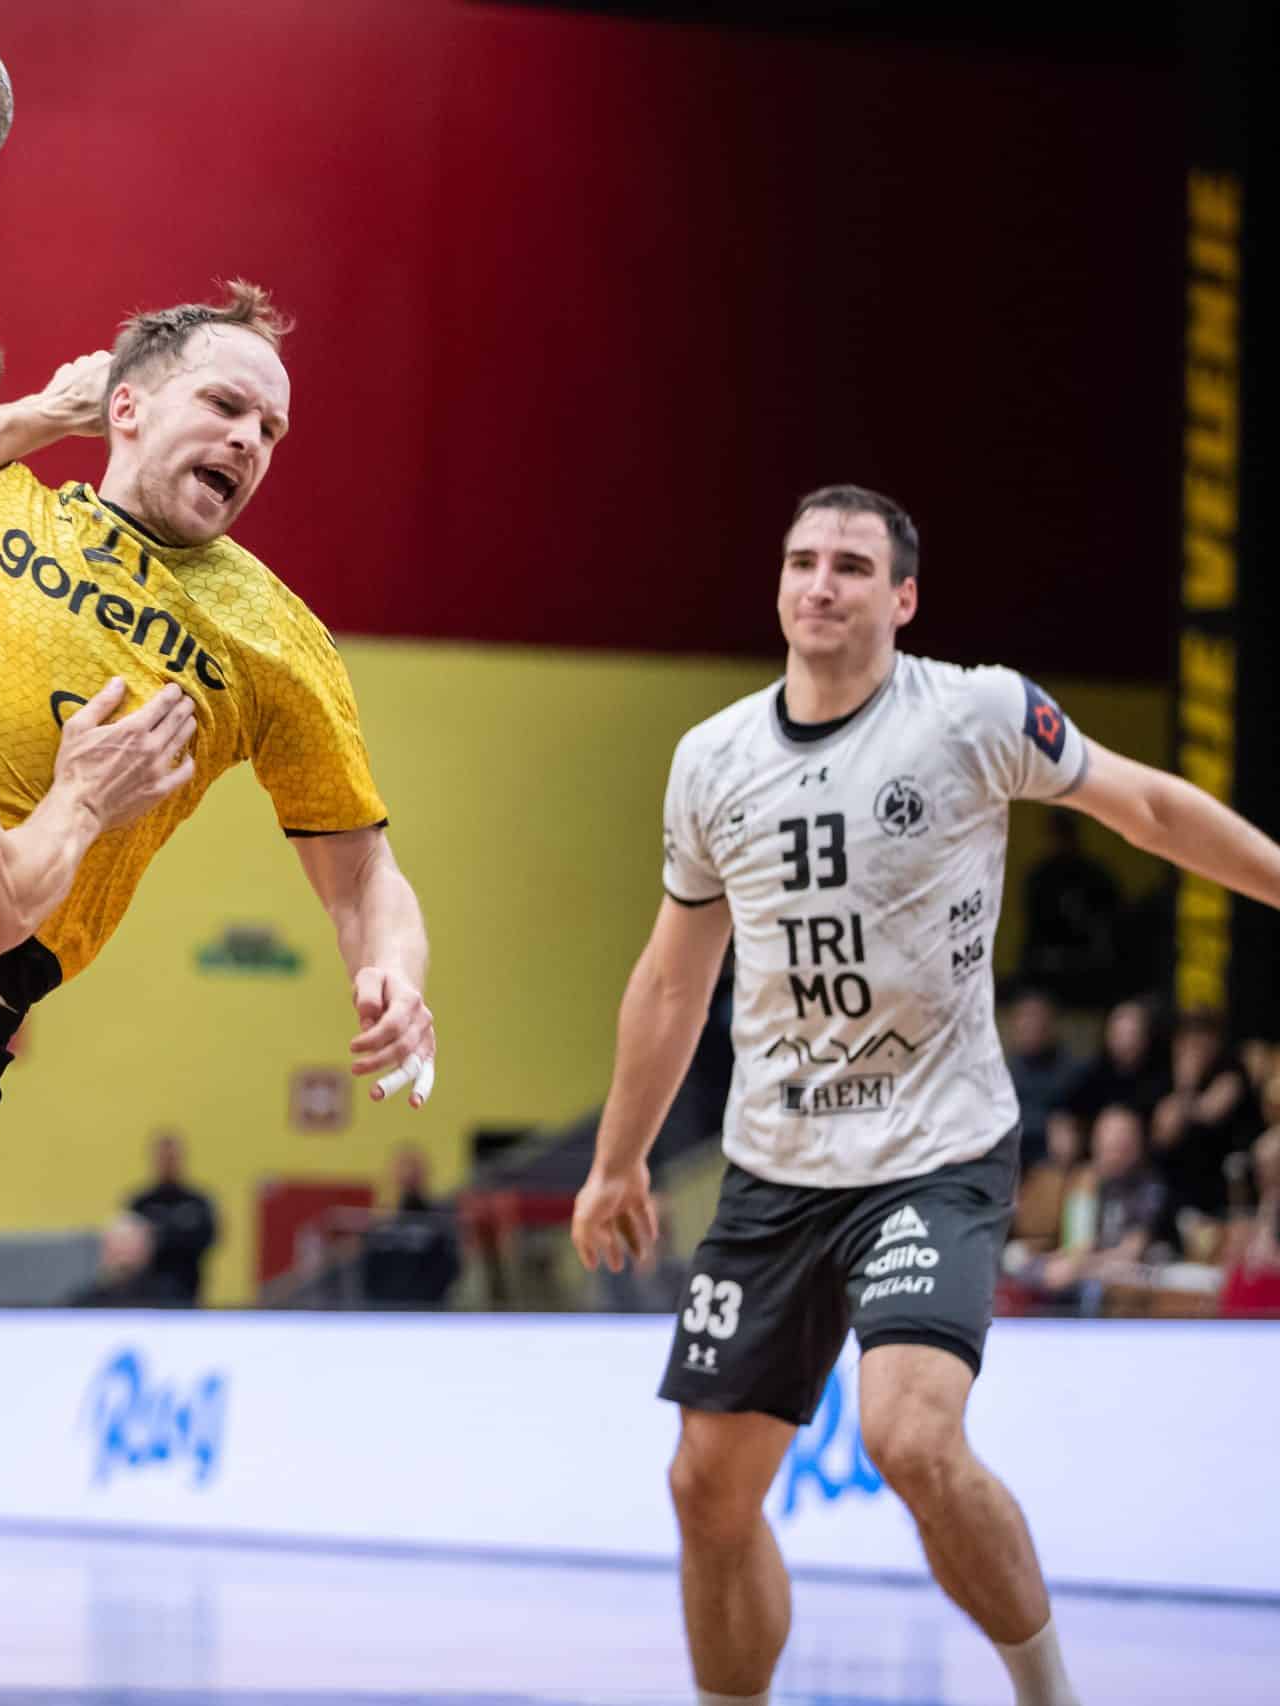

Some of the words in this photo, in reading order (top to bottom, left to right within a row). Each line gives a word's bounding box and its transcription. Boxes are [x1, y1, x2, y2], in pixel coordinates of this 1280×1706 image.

[779, 812, 847, 891] 33
[777, 912, 865, 967] TRI
[789, 972, 872, 1019] MO
[684, 1273, 743, 1339] 33
